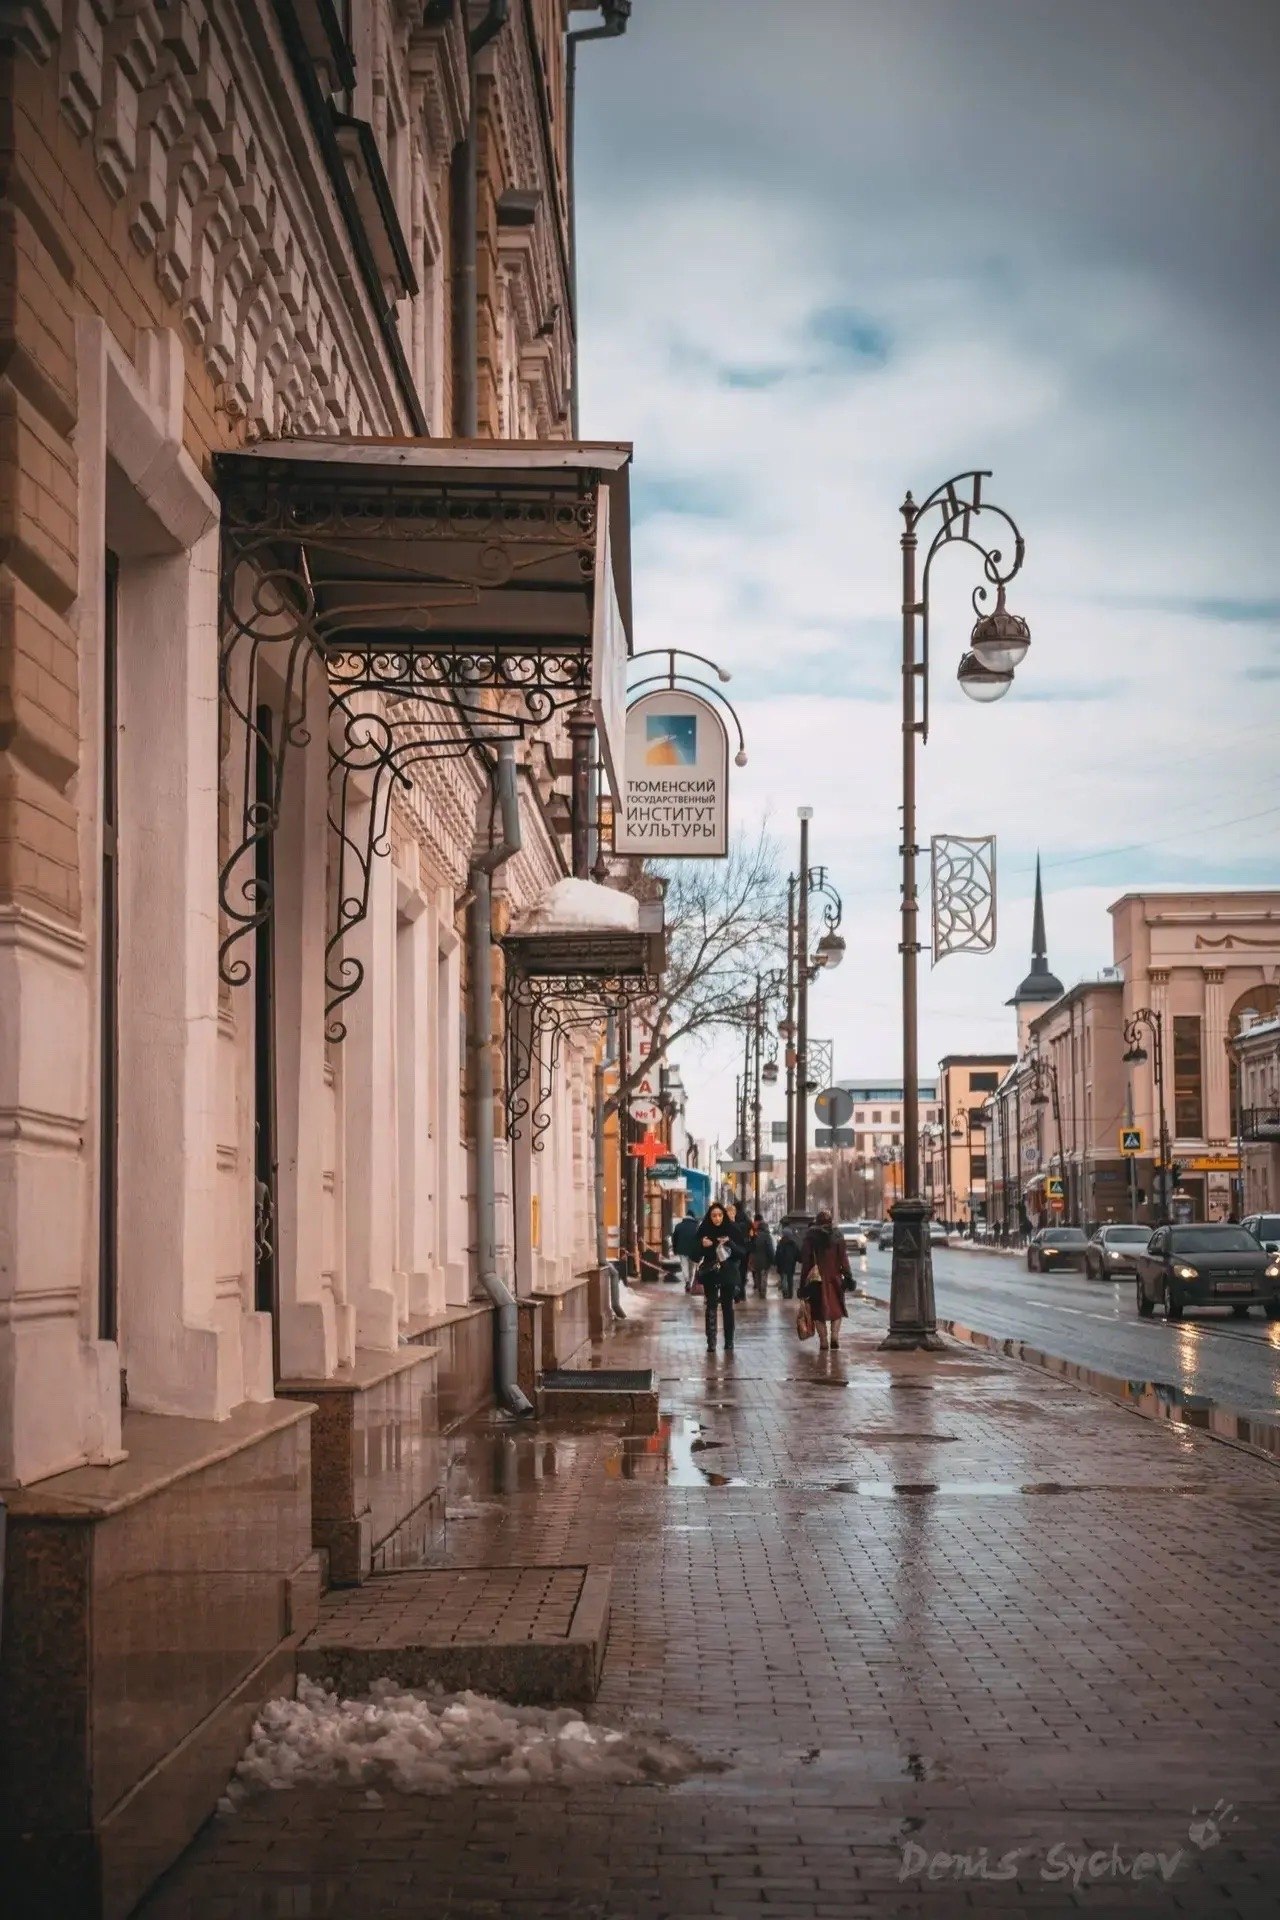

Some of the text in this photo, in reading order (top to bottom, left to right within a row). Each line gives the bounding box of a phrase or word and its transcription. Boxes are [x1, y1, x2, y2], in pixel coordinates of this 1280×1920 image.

[627, 779, 716, 792] ТЮМЕНСКИЙ
[627, 795, 716, 804] ГОСУДАРСТВЕННЫЙ
[626, 807, 715, 821] ИНСТИТУТ
[626, 823, 716, 837] КУЛЬТУРЫ
